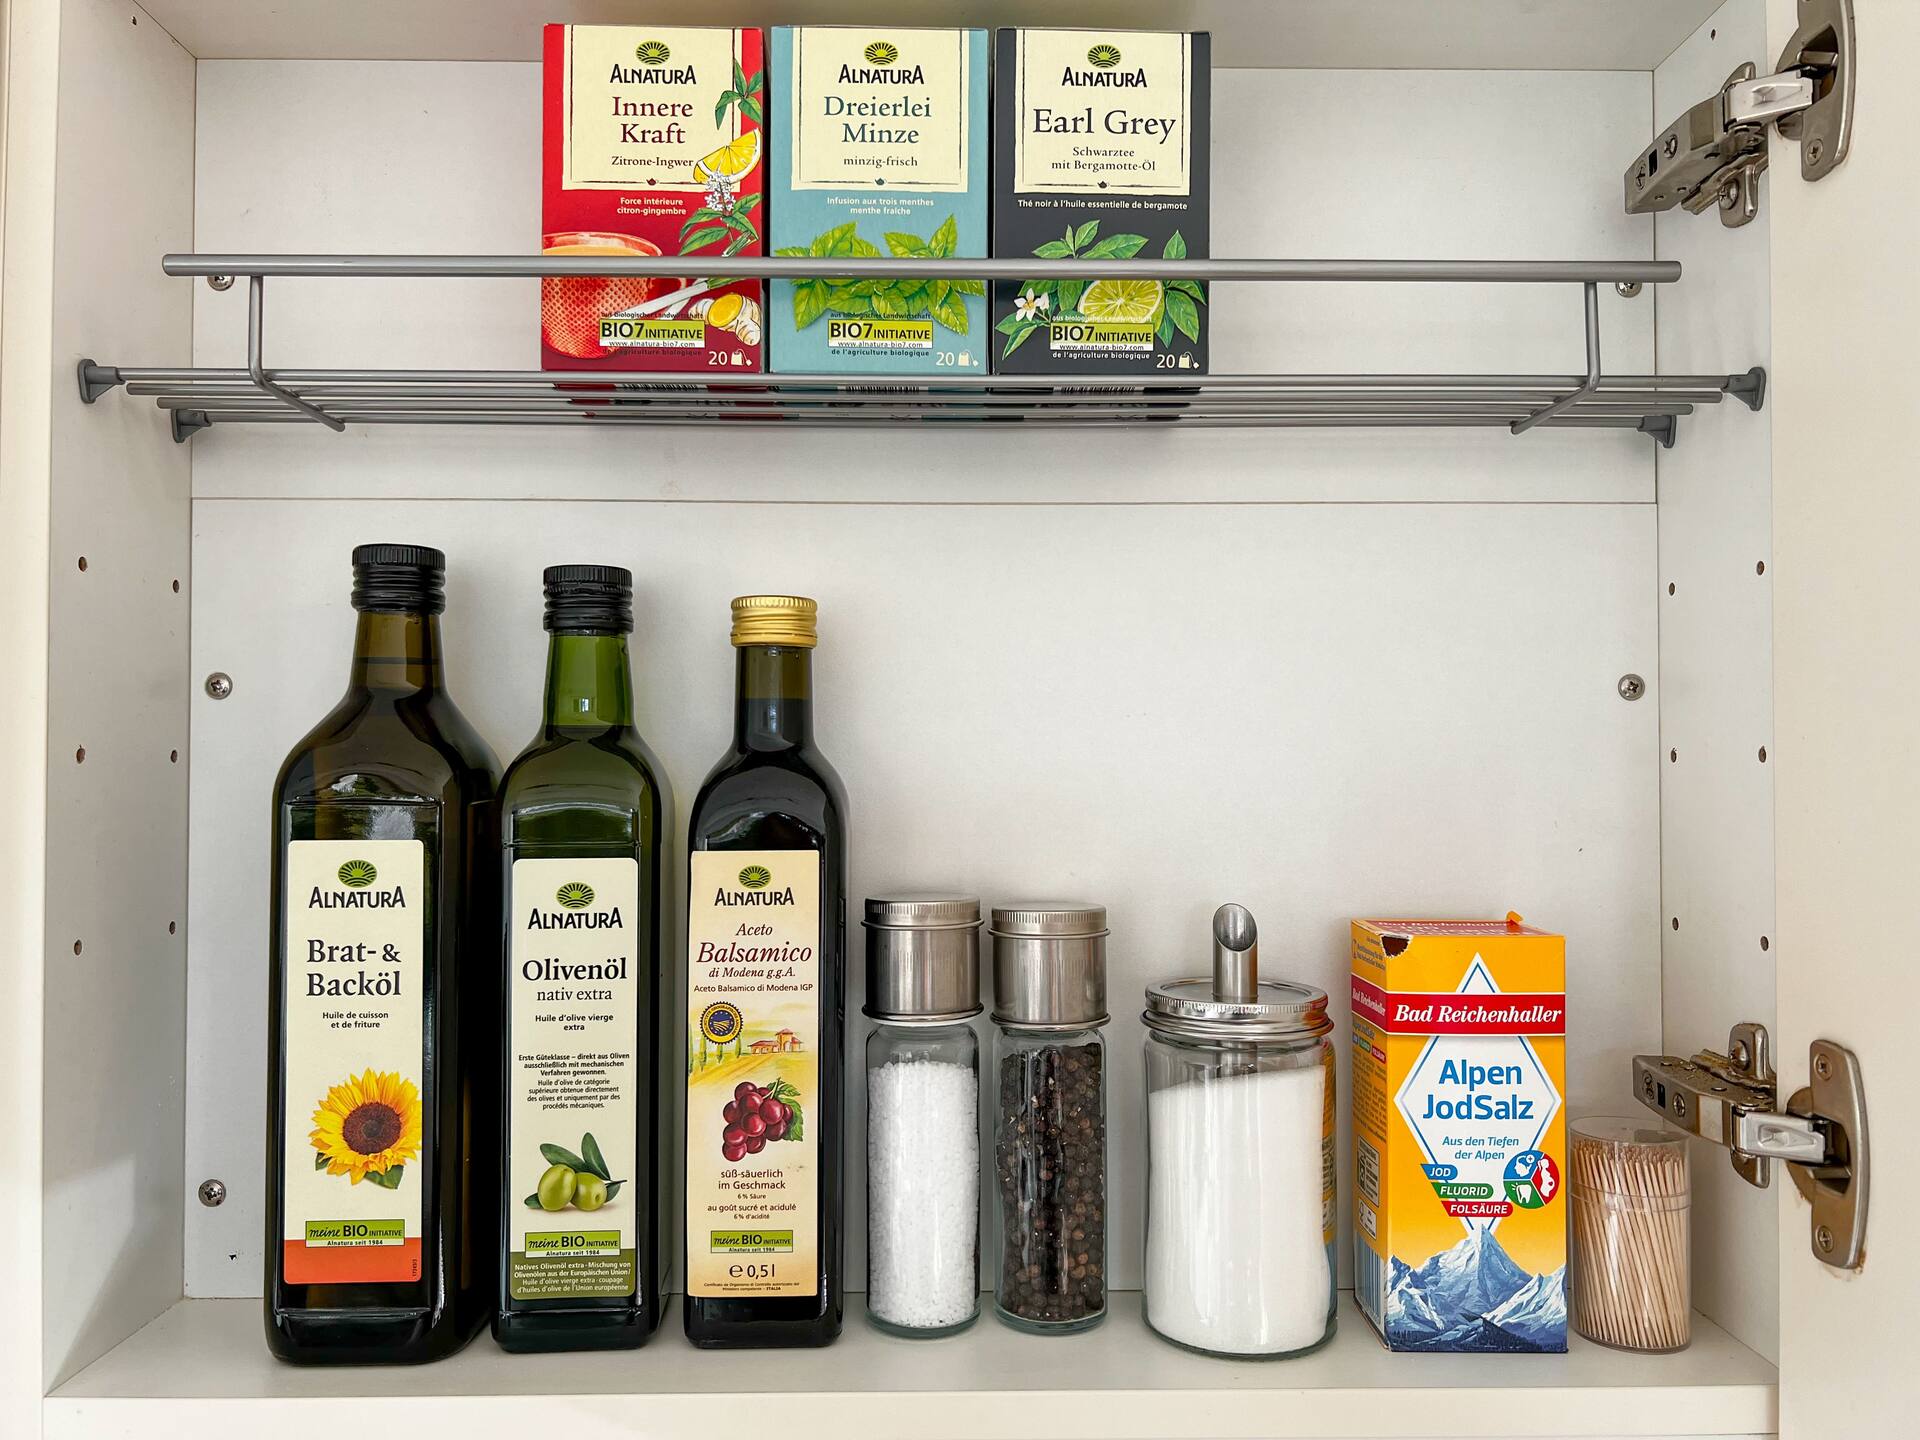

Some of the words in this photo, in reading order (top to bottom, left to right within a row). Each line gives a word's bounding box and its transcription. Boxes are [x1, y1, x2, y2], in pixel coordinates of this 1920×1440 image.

[610, 64, 696, 84] ALNATURA
[838, 64, 924, 84] ALNATURA
[1061, 67, 1147, 88] ALNATURA
[612, 96, 693, 117] Innere
[824, 96, 932, 117] Dreierlei
[1033, 108, 1094, 134] Earl
[1104, 109, 1176, 144] Grey
[620, 122, 686, 144] Kraft
[841, 123, 919, 144] Minze
[1072, 147, 1135, 157] Schwarztee
[611, 156, 694, 169] Zitrone-Ingwer
[843, 156, 918, 168] minzig-frisch
[1052, 160, 1070, 170] mit
[1074, 160, 1156, 173] Bergamotte-Öl
[620, 197, 641, 205] Force
[644, 197, 683, 206] intérieure
[900, 198, 934, 206] menthes
[1060, 200, 1086, 208] l'huile
[1087, 200, 1130, 209] essentielle
[1144, 201, 1187, 210] bergamote
[617, 207, 686, 216] citron-gingembre
[708, 352, 728, 366] 20
[936, 352, 954, 366] 20
[1157, 355, 1175, 368] 20
[309, 886, 406, 908] ALNATURA
[714, 887, 794, 906] ALNATURA
[528, 907, 623, 929] ALNATURA
[736, 923, 773, 936] Aceto
[307, 939, 376, 963] Brat-
[382, 943, 401, 963] &
[696, 941, 812, 963] Balsamico
[522, 957, 627, 981] Olivenöl
[709, 968, 719, 978] di
[722, 967, 764, 978] Modena
[766, 967, 796, 979] g.g.A.
[306, 971, 401, 996] Backöl
[537, 987, 573, 1001] nativ
[576, 989, 612, 1000] extra
[588, 1014, 614, 1023] vierge
[1394, 1005, 1433, 1022] Bad
[1436, 1006, 1562, 1022] Reichenhaller
[1439, 1060, 1522, 1091] Alpen
[1423, 1094, 1534, 1120] JodSalz
[1442, 1136, 1463, 1146] Aus
[1465, 1136, 1484, 1146] den
[1487, 1137, 1519, 1146] Tiefen
[1455, 1150, 1472, 1159] der
[1474, 1150, 1505, 1162] Alpen
[721, 1170, 783, 1178] süß-säuerlich
[1430, 1168, 1450, 1176] JOD
[733, 1181, 786, 1189] Geschmack
[1440, 1187, 1488, 1196] FLUORID
[719, 1204, 736, 1213] goût
[1450, 1203, 1508, 1214] FOLSÄURE
[309, 1227, 340, 1238] meine
[343, 1225, 368, 1237] BIO
[528, 1239, 560, 1248] meine
[561, 1236, 585, 1248] BIO
[714, 1236, 740, 1245] meine
[741, 1235, 762, 1245] BIO
[571, 1269, 609, 1277] Europäischen
